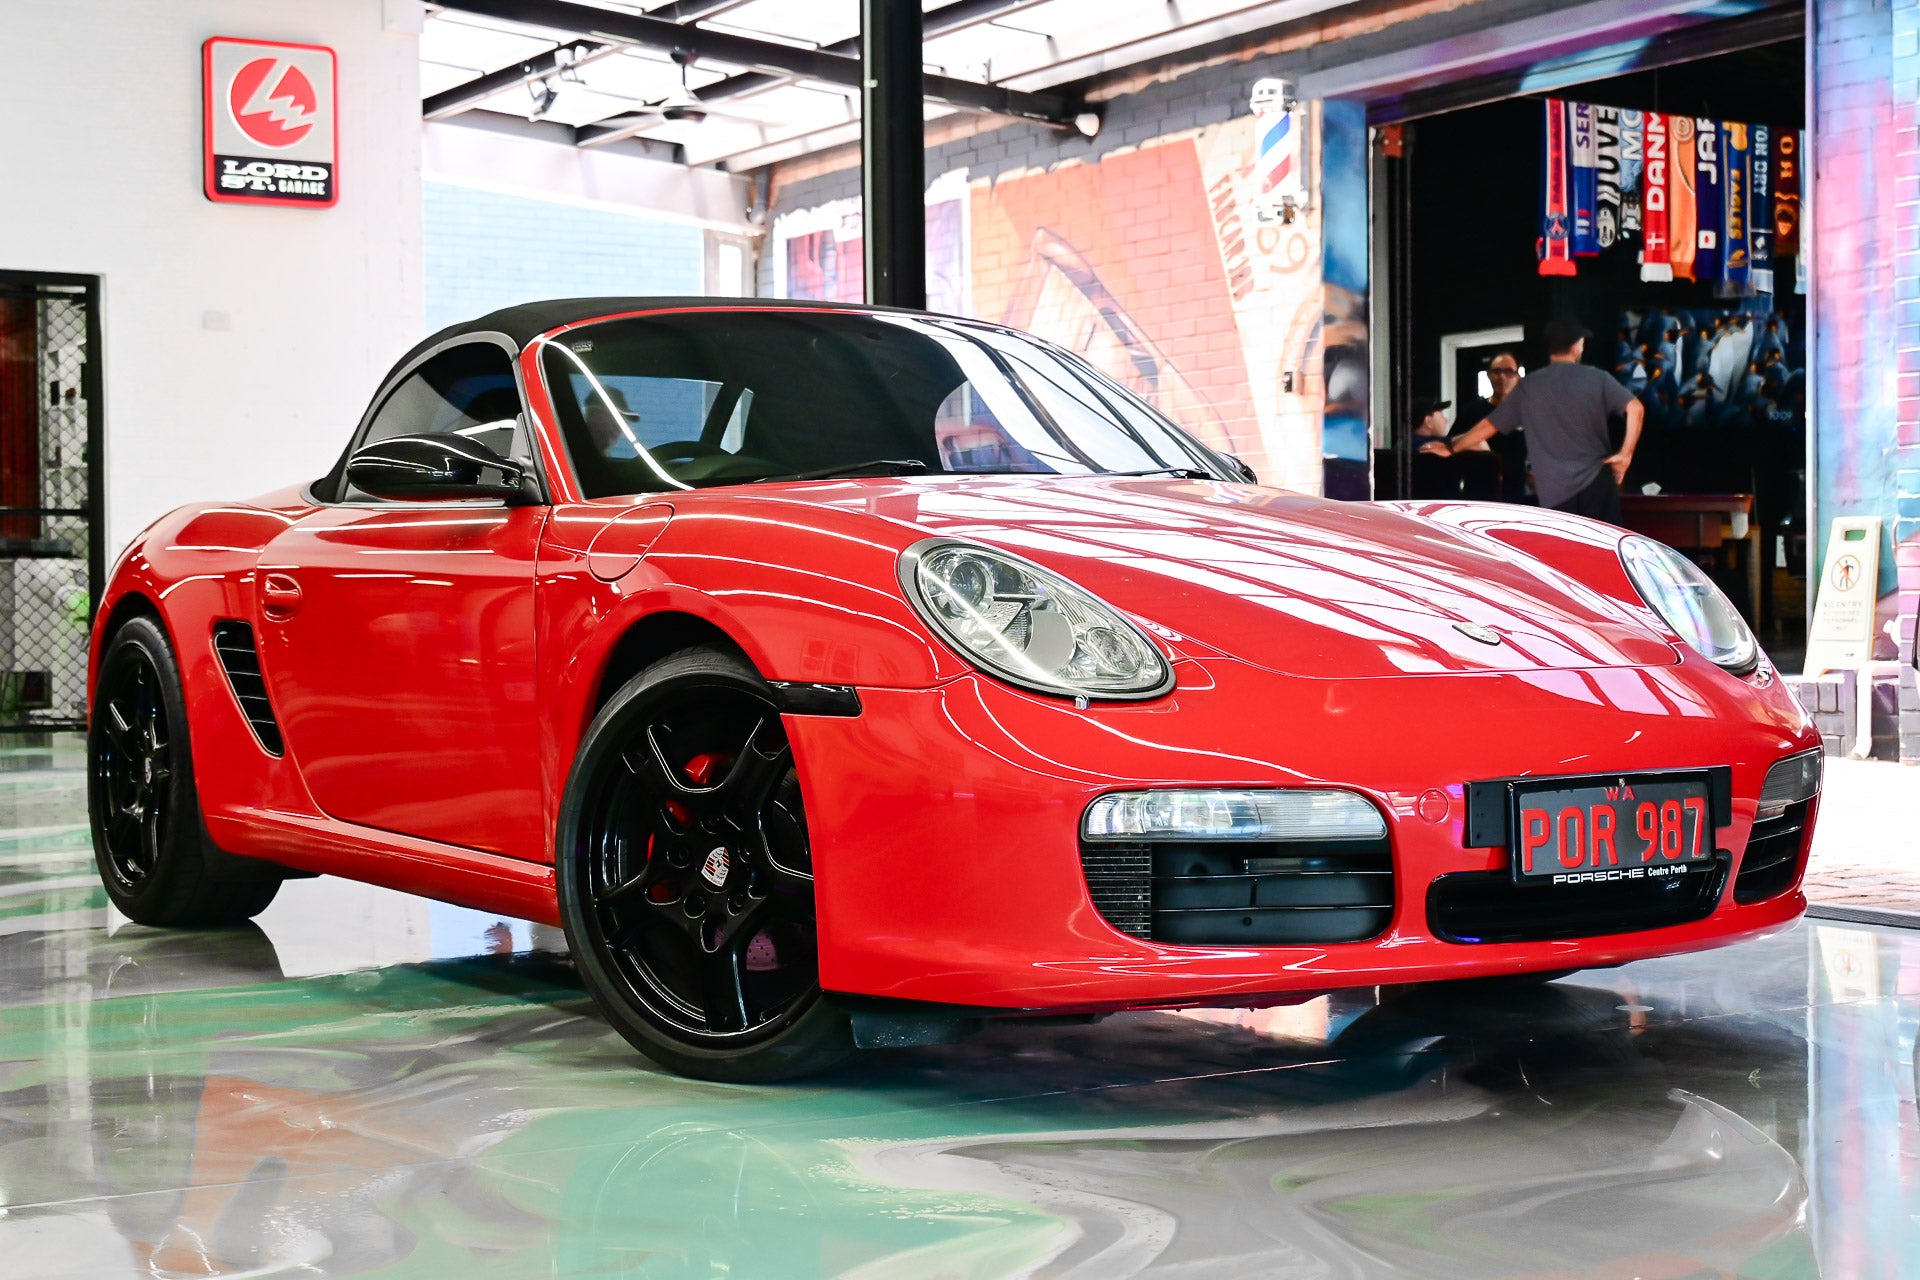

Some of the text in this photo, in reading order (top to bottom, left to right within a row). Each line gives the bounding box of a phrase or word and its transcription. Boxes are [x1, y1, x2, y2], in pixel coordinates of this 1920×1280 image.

[223, 160, 329, 181] LORD
[221, 175, 326, 195] ST. GARAGE
[1730, 168, 1743, 240] EAGLES
[1521, 796, 1706, 872] POR 987
[1553, 864, 1688, 885] PORSCHE Centre Perth
